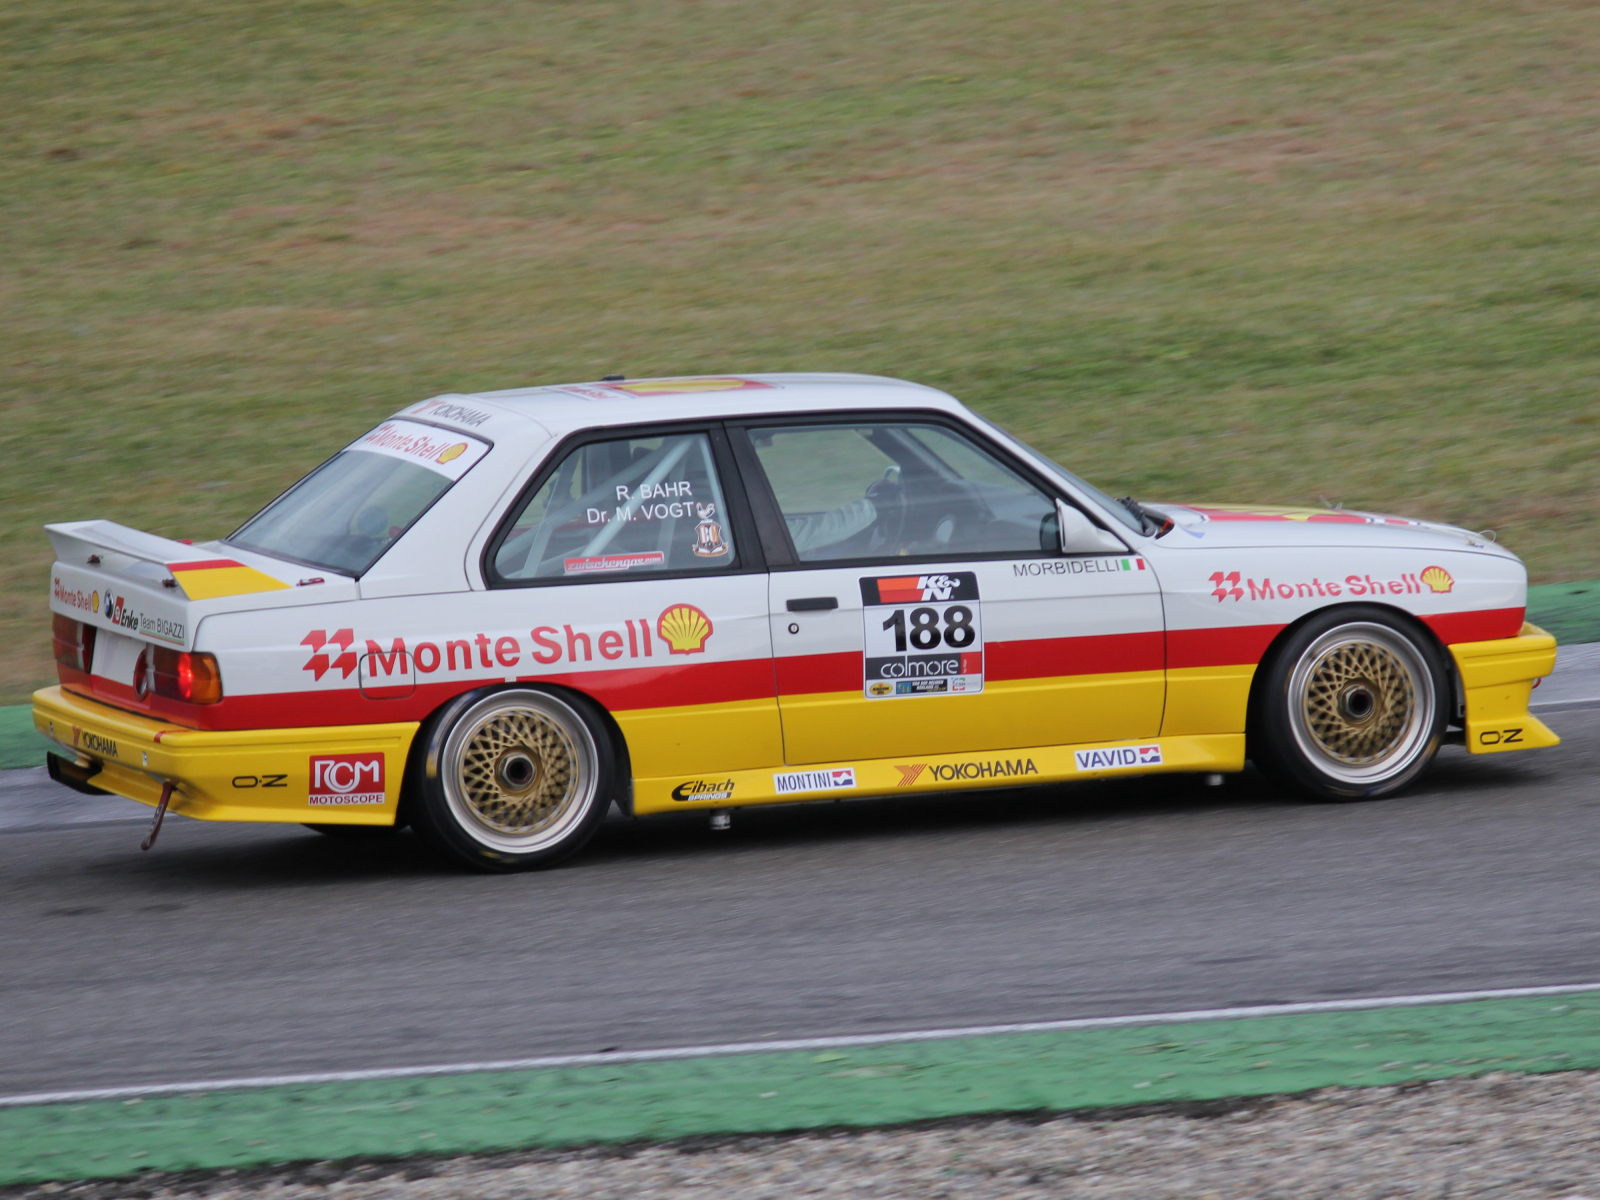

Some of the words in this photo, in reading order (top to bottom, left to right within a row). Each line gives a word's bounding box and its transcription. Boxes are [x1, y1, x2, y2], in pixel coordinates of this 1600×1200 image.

[428, 403, 491, 427] YOKOHAMA
[371, 429, 412, 451] Monte
[404, 436, 450, 460] Shell
[616, 485, 635, 501] R.
[640, 481, 693, 500] BAHR
[587, 507, 611, 524] Dr.
[616, 506, 637, 521] M.
[641, 501, 694, 520] VOGT
[1013, 559, 1120, 577] MORBIDELLI
[60, 585, 77, 604] Monte
[77, 590, 92, 612] Shell
[1247, 578, 1342, 601] Monte
[1345, 573, 1421, 596] Shell
[140, 613, 156, 630] Team
[157, 618, 185, 639] BIGAZZI
[883, 605, 975, 652] 188
[365, 633, 522, 677] Monte
[531, 619, 654, 665] Shell
[880, 655, 959, 677] colmore
[82, 730, 119, 758] YOKOHAMA
[928, 758, 1038, 781] YOKOHAMA
[1076, 748, 1137, 769] VAVID
[314, 760, 379, 793] RCM
[777, 772, 832, 792] MONTINI
[309, 794, 383, 805] MOTOSCOPE
[671, 778, 735, 802] Eibach
[687, 791, 729, 802] SPRINGS
